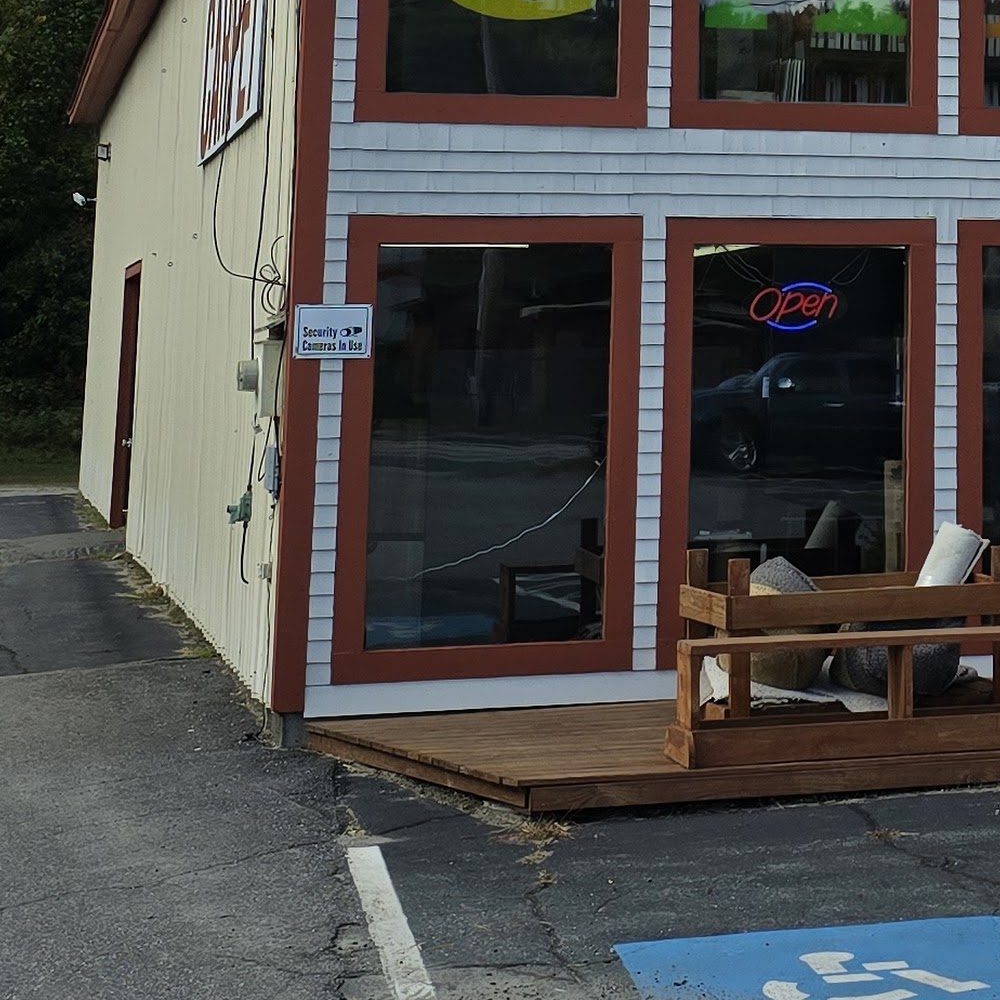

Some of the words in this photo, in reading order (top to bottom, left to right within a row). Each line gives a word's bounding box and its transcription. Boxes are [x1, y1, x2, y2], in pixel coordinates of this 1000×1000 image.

[749, 287, 838, 323] Open
[303, 326, 338, 340] Security
[302, 340, 337, 351] Cameras
[338, 340, 347, 351] In
[348, 340, 363, 351] Use
